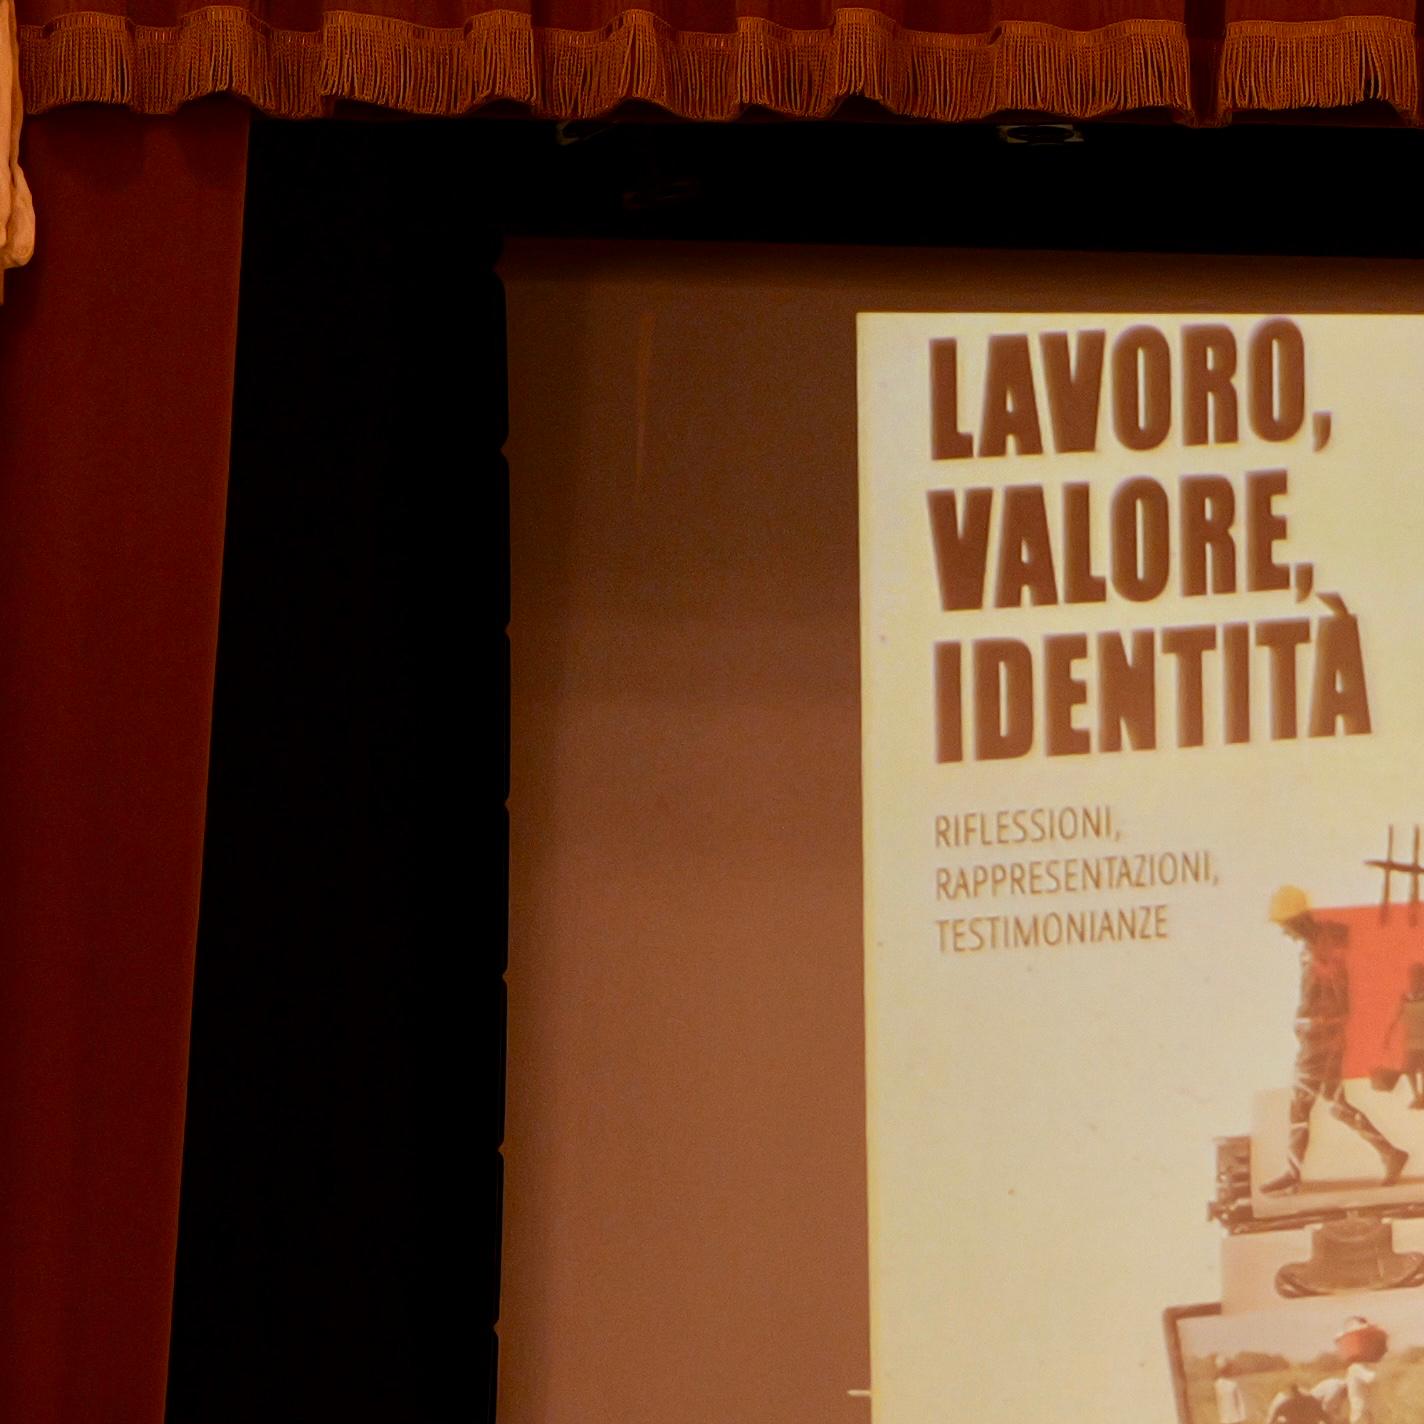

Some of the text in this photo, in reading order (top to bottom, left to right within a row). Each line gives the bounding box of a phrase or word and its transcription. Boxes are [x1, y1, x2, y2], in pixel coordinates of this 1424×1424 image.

[928, 316, 1332, 460] LAVORO,
[926, 468, 1314, 612] VALORE,
[932, 592, 1372, 764] IDENTITÀ
[935, 805, 1121, 848] RIFLESSIONI,
[935, 851, 1219, 901] RAPPRESENTAZIONI,
[936, 905, 1168, 953] TESTIMONIANZE
